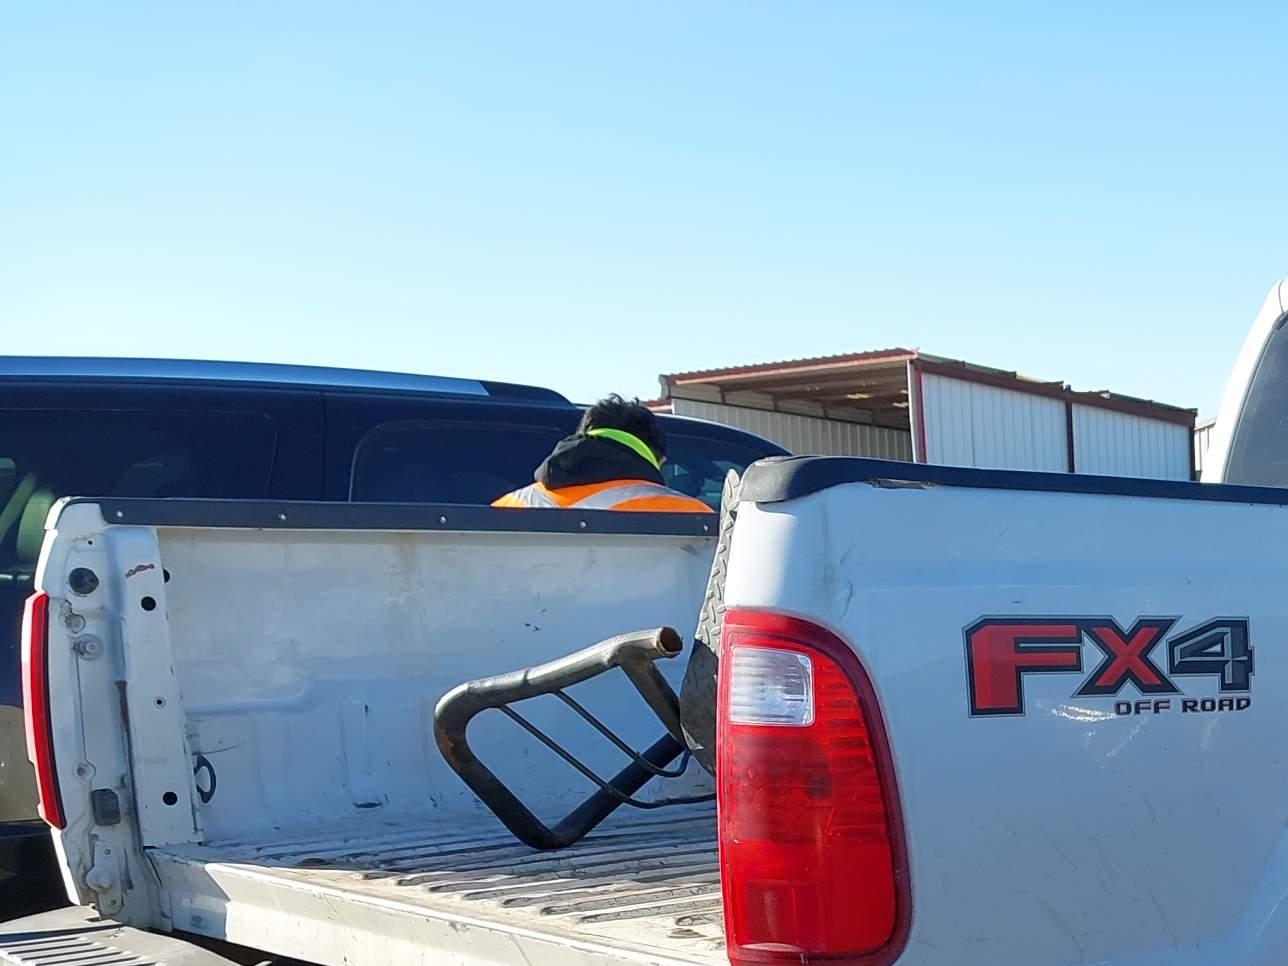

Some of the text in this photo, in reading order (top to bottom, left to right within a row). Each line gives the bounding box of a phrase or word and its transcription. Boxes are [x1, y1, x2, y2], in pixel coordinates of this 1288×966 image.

[962, 615, 1254, 718] FX4
[1115, 697, 1251, 715] OFF ROAD
